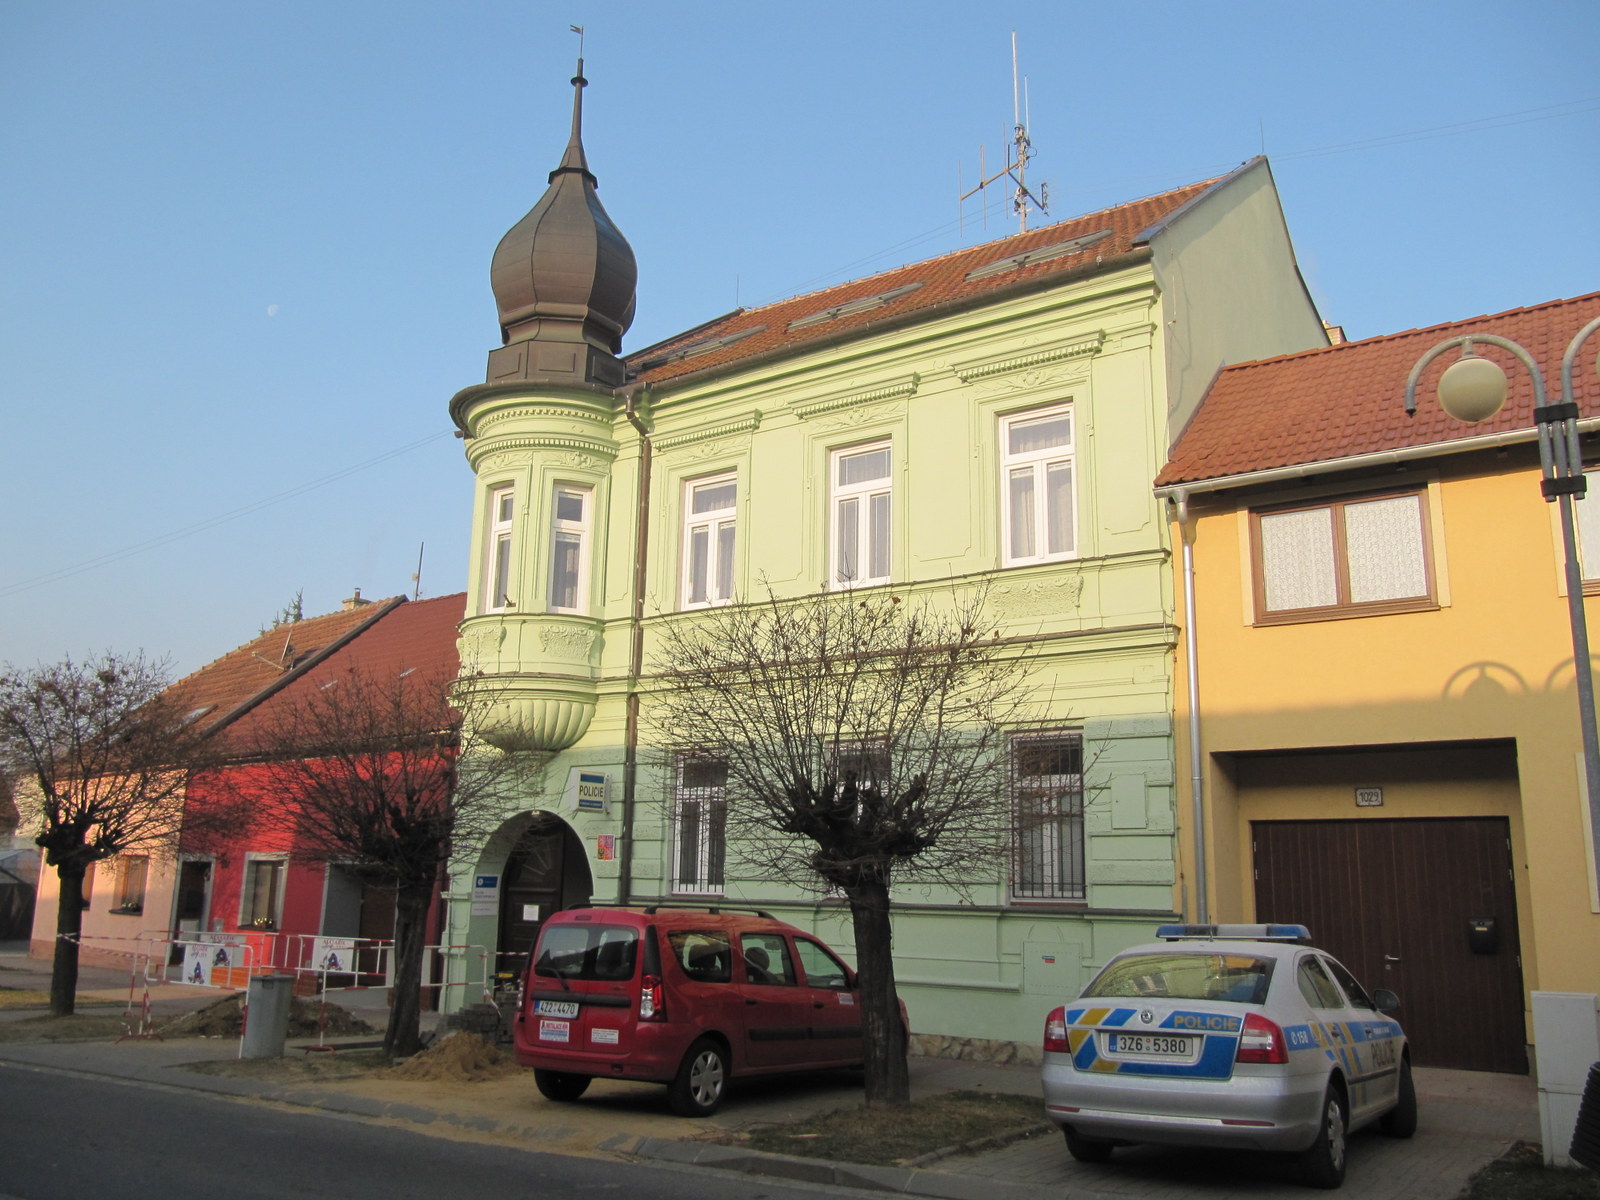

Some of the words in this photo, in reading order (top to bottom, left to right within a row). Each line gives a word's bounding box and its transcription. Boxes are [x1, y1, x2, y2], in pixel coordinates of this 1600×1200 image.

[579, 785, 603, 797] POLICIE
[1360, 791, 1379, 802] 1029
[557, 1003, 575, 1015] 4470
[1174, 1015, 1239, 1032] POLICIE
[1120, 1037, 1142, 1051] 3Z6
[1153, 1039, 1186, 1053] 5380
[1371, 1040, 1395, 1067] POLICIE
